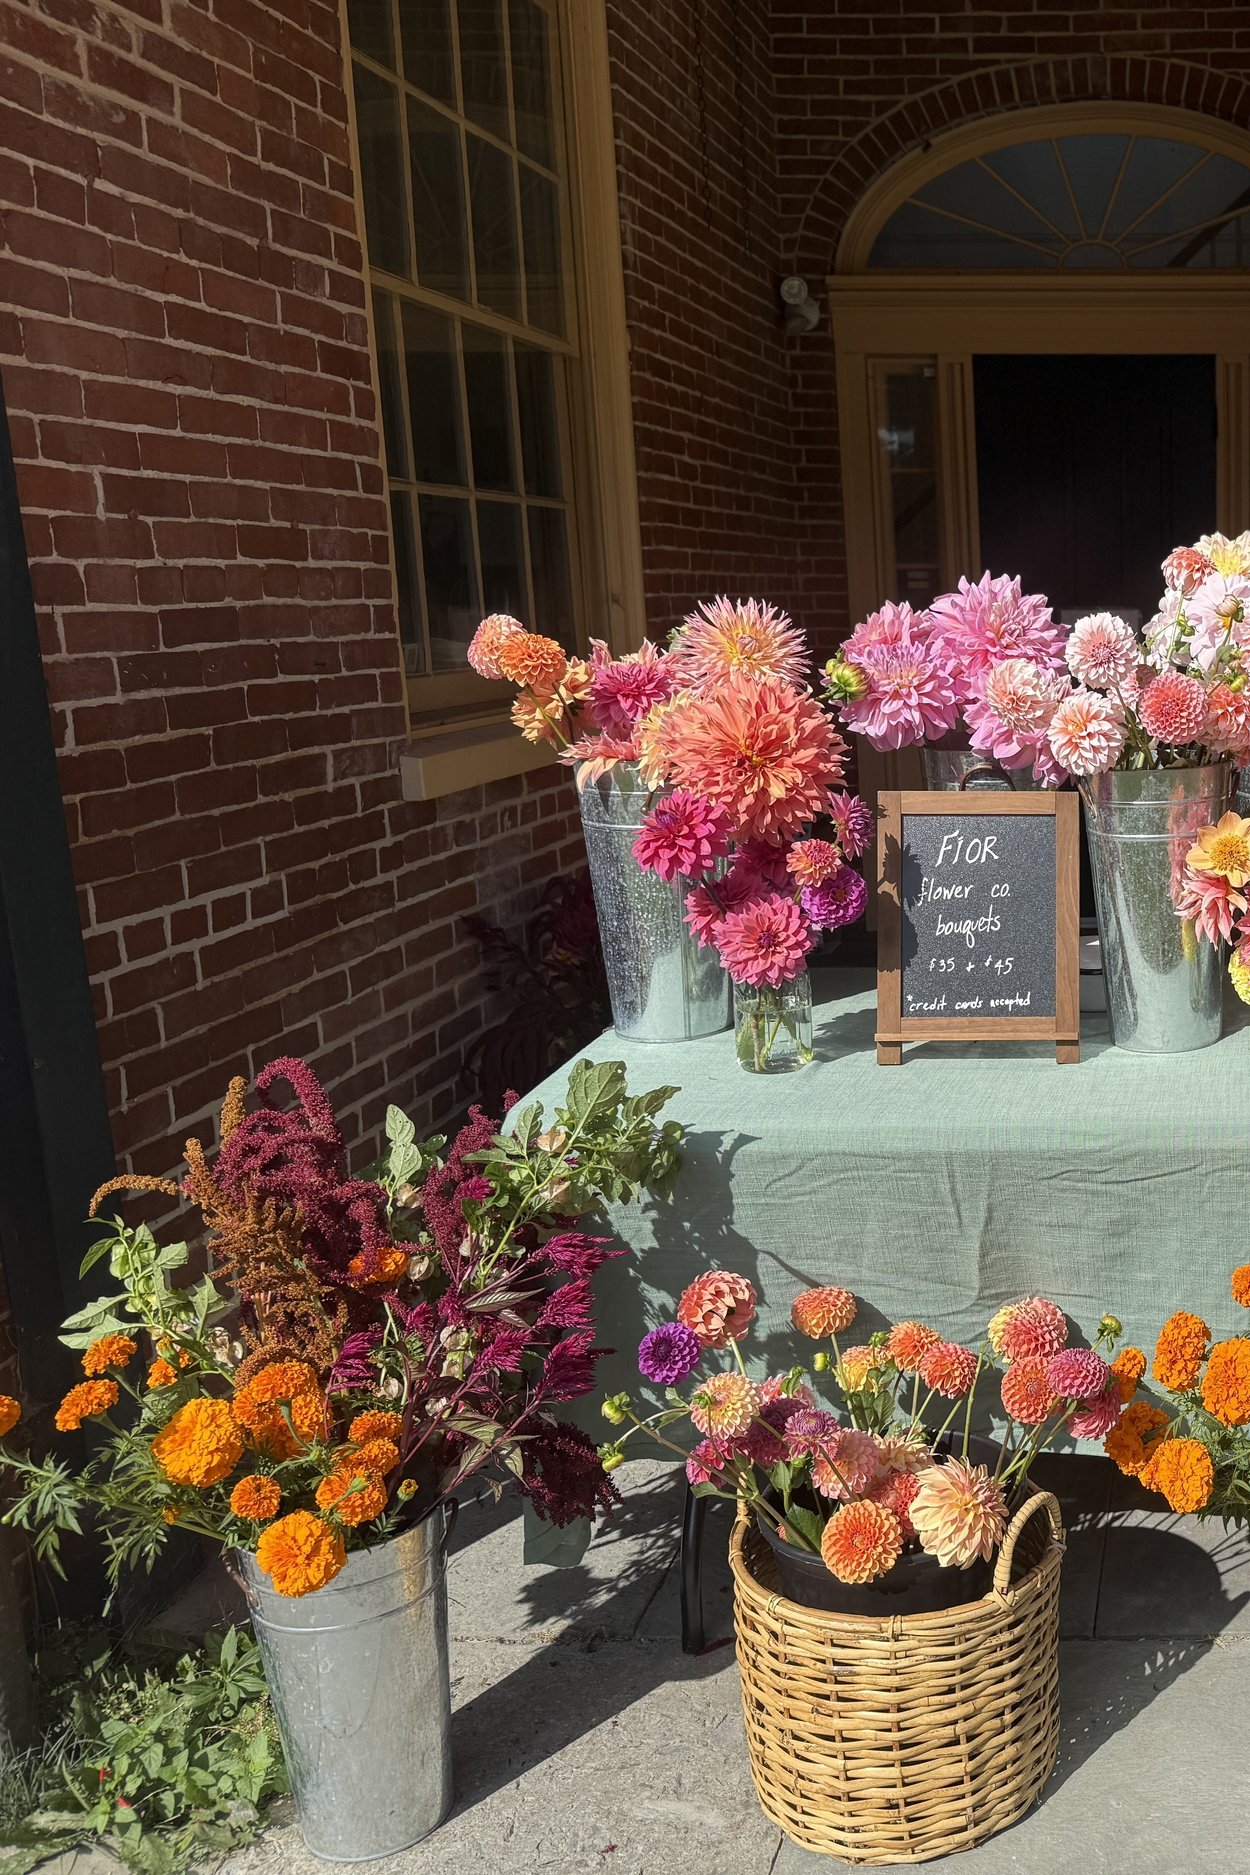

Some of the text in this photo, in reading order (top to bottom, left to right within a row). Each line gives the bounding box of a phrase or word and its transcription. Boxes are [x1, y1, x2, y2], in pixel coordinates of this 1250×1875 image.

[917, 877, 1010, 906] flower co.
[935, 904, 1001, 948] bouquets
[929, 957, 955, 972] $35
[985, 955, 1014, 975] $45
[955, 998, 983, 1010] cards
[990, 992, 1030, 1012] accepted
